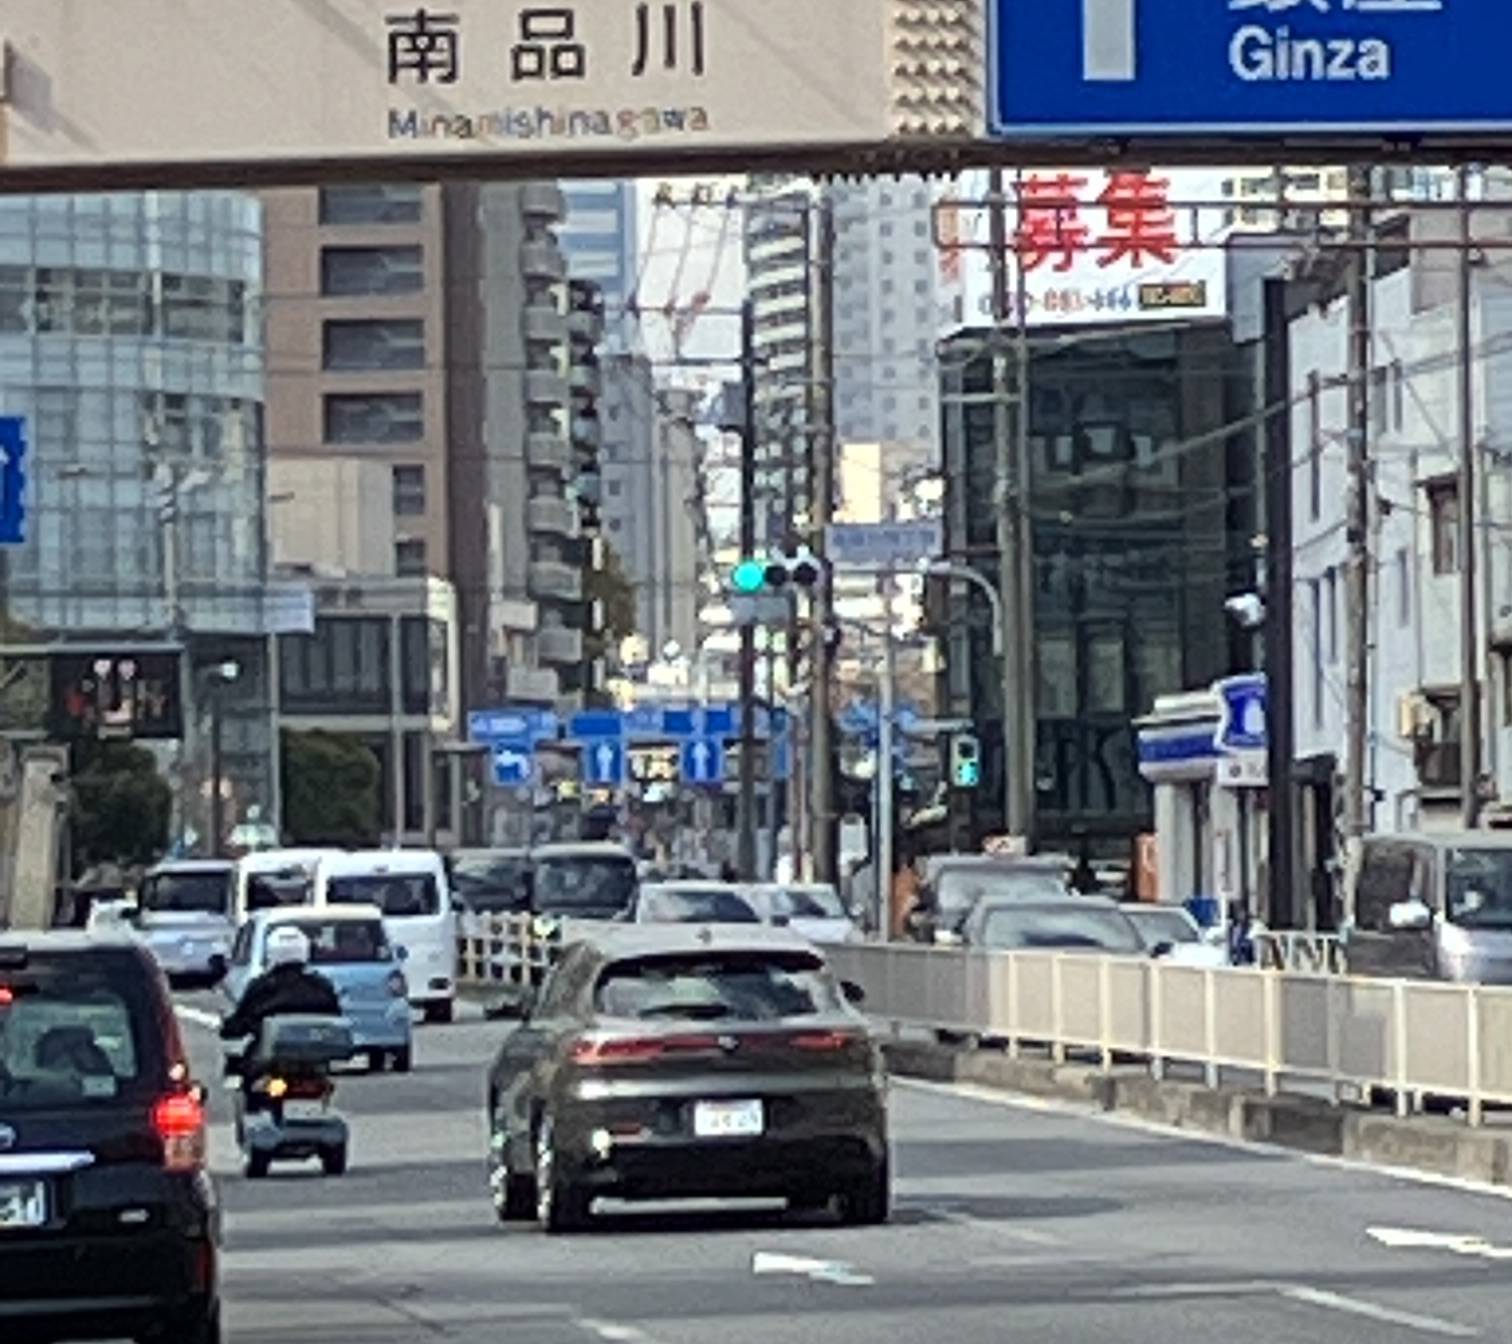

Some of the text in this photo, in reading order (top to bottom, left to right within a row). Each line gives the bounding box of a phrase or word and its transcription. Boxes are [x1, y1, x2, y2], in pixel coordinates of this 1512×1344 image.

[385, 0, 704, 85] 南品川
[1230, 25, 1389, 81] Ginza
[387, 107, 709, 140] Minamishinagawa
